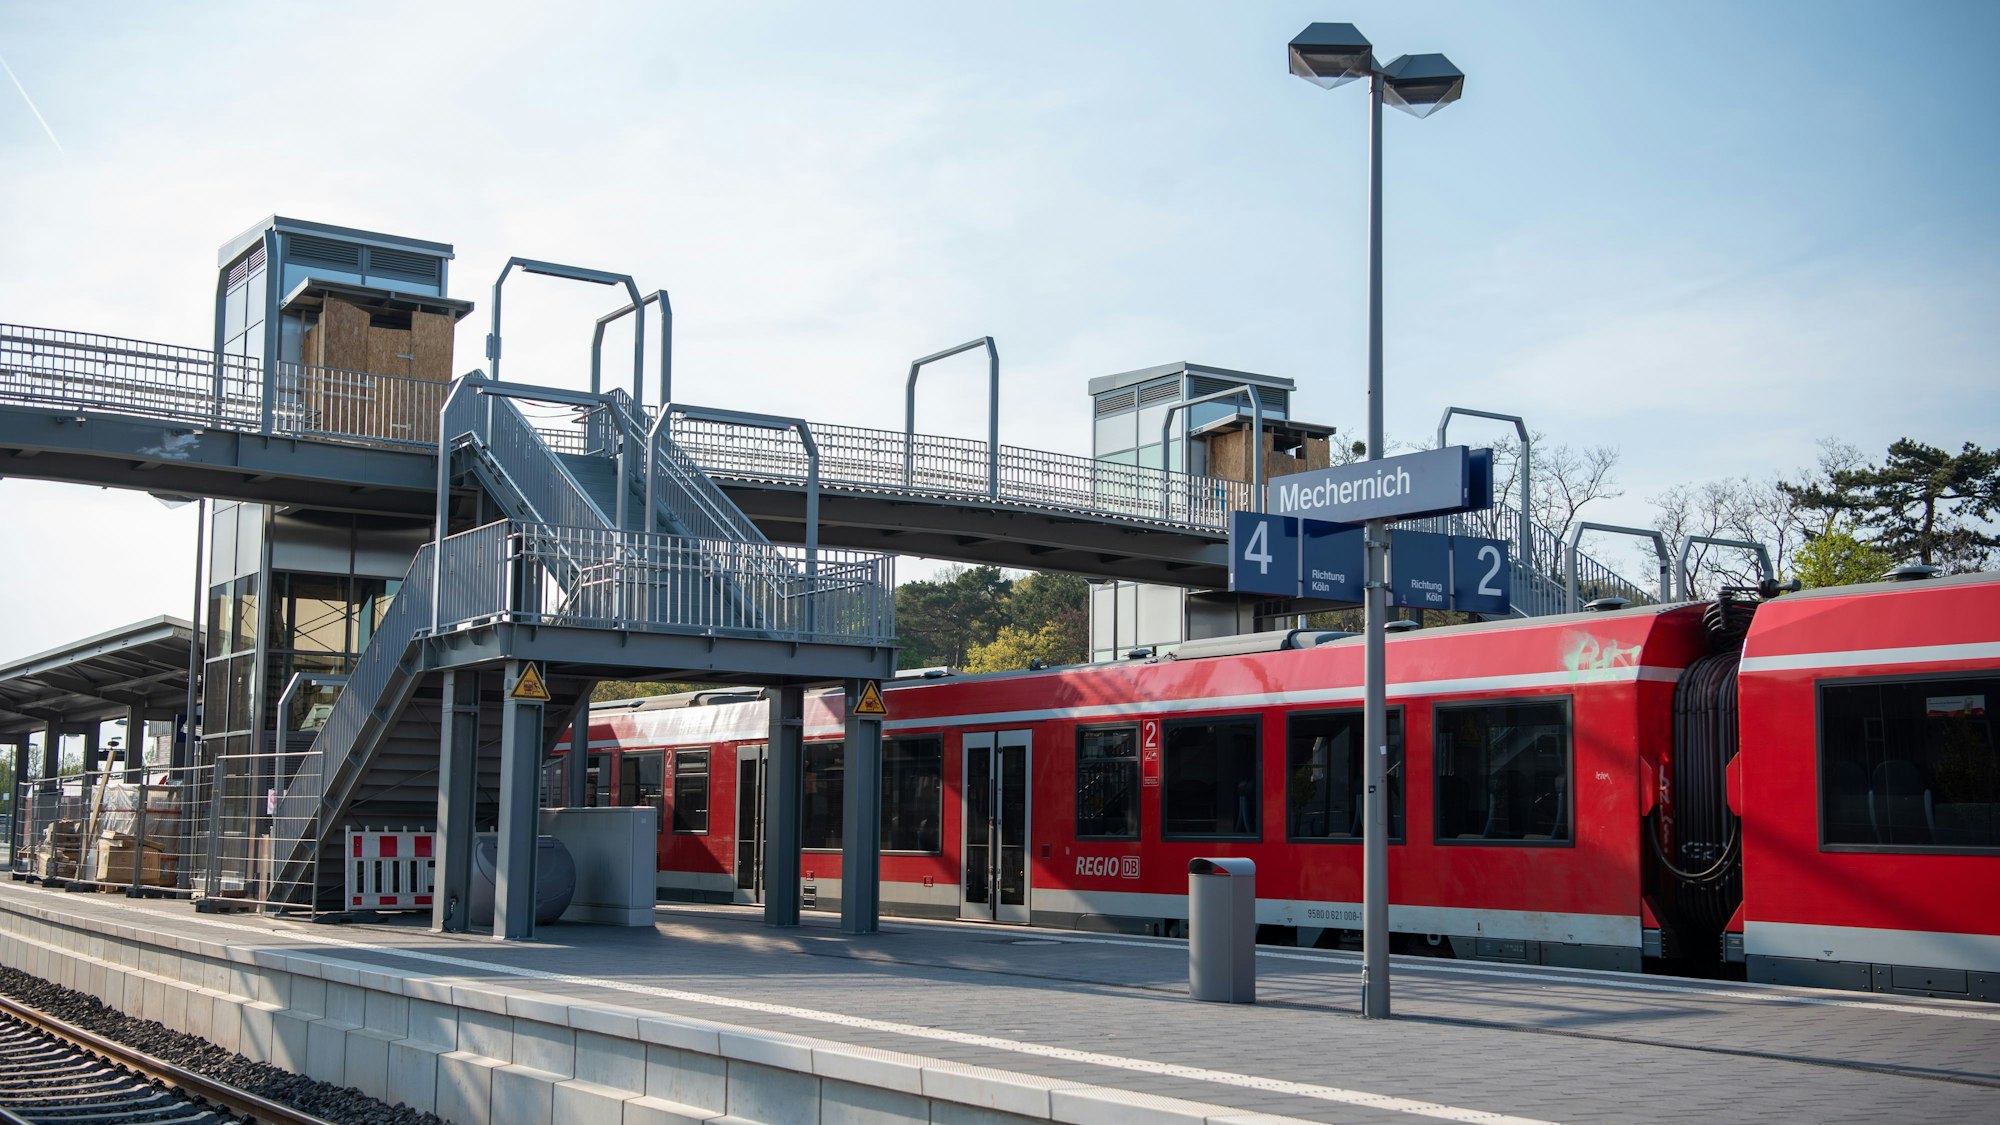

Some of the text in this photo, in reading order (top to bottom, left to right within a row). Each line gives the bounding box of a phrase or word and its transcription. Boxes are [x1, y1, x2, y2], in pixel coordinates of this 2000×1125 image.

[1279, 466, 1410, 512] Mechernich
[1244, 520, 1272, 574] 4
[1312, 569, 1345, 583] Richtung
[1477, 545, 1502, 596] 2
[1312, 581, 1329, 591] Köln
[1411, 579, 1442, 592] Richtung
[1426, 592, 1442, 602] Köln
[1145, 721, 1156, 747] 2
[666, 750, 672, 768] 2
[1075, 856, 1119, 876] REGIO
[1123, 859, 1138, 876] DB
